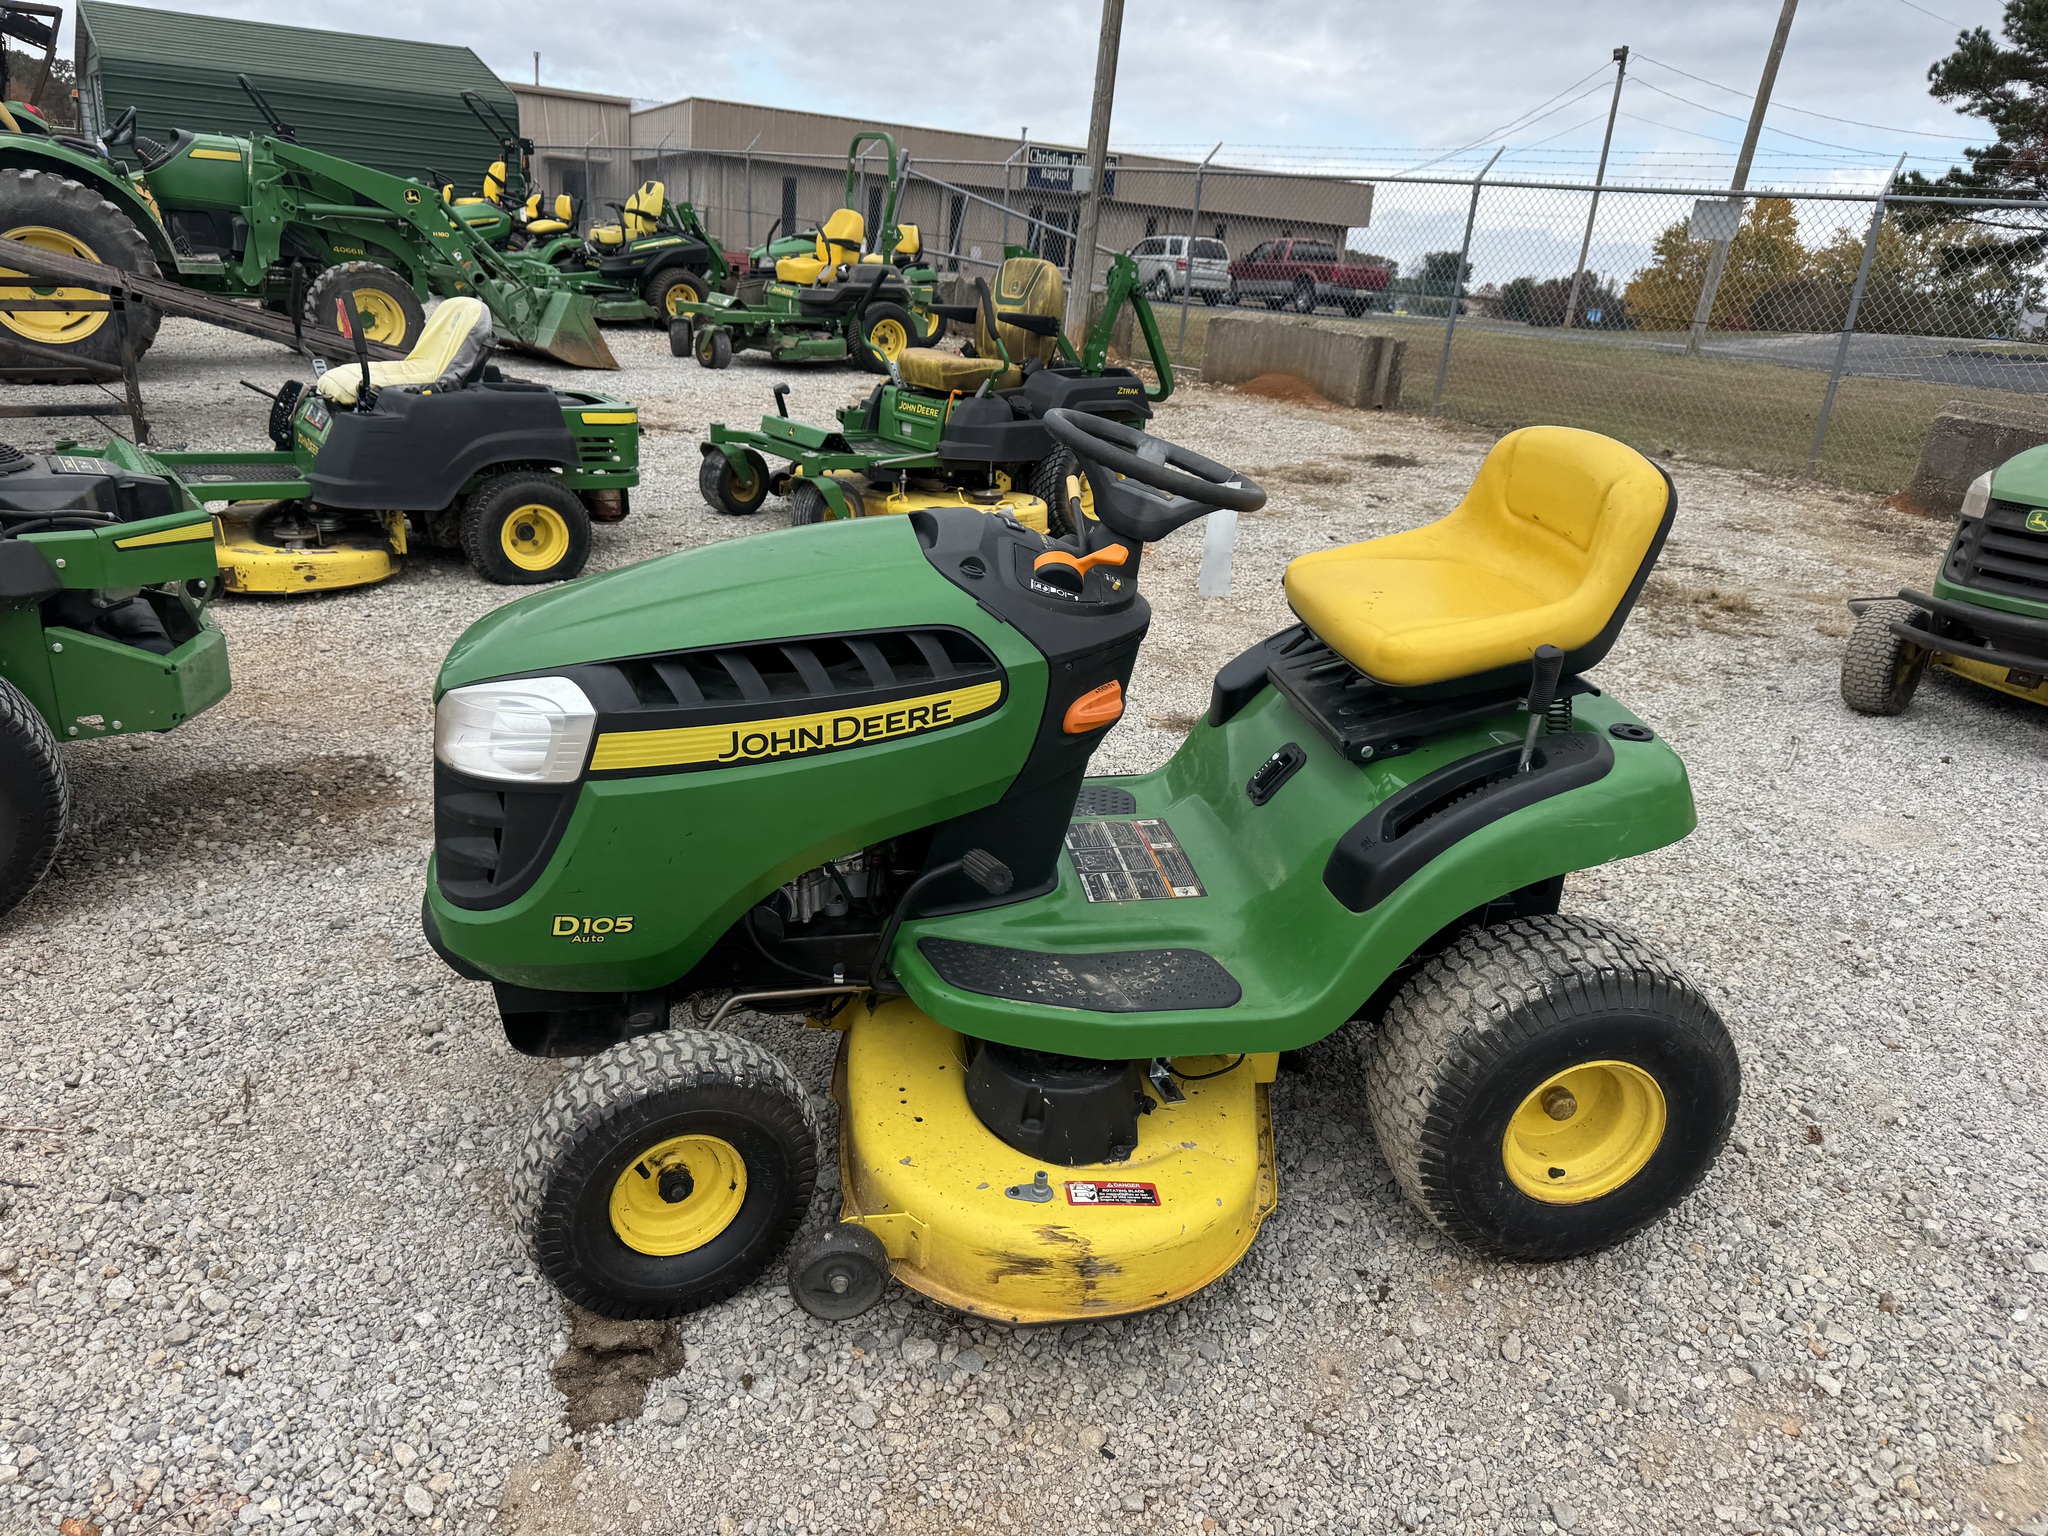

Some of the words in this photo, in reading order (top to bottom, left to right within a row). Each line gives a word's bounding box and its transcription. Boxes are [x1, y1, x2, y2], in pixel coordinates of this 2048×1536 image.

[1029, 148, 1069, 165] Christian
[1071, 153, 1115, 168] Fellip
[1041, 167, 1070, 182] Baptist
[333, 245, 364, 256] 4066R
[898, 400, 917, 412] JOHN
[916, 404, 940, 418] DEERE
[718, 724, 824, 760] JOHN
[832, 699, 952, 744] DEERE
[552, 915, 634, 936] D105
[571, 934, 605, 943] Auto
